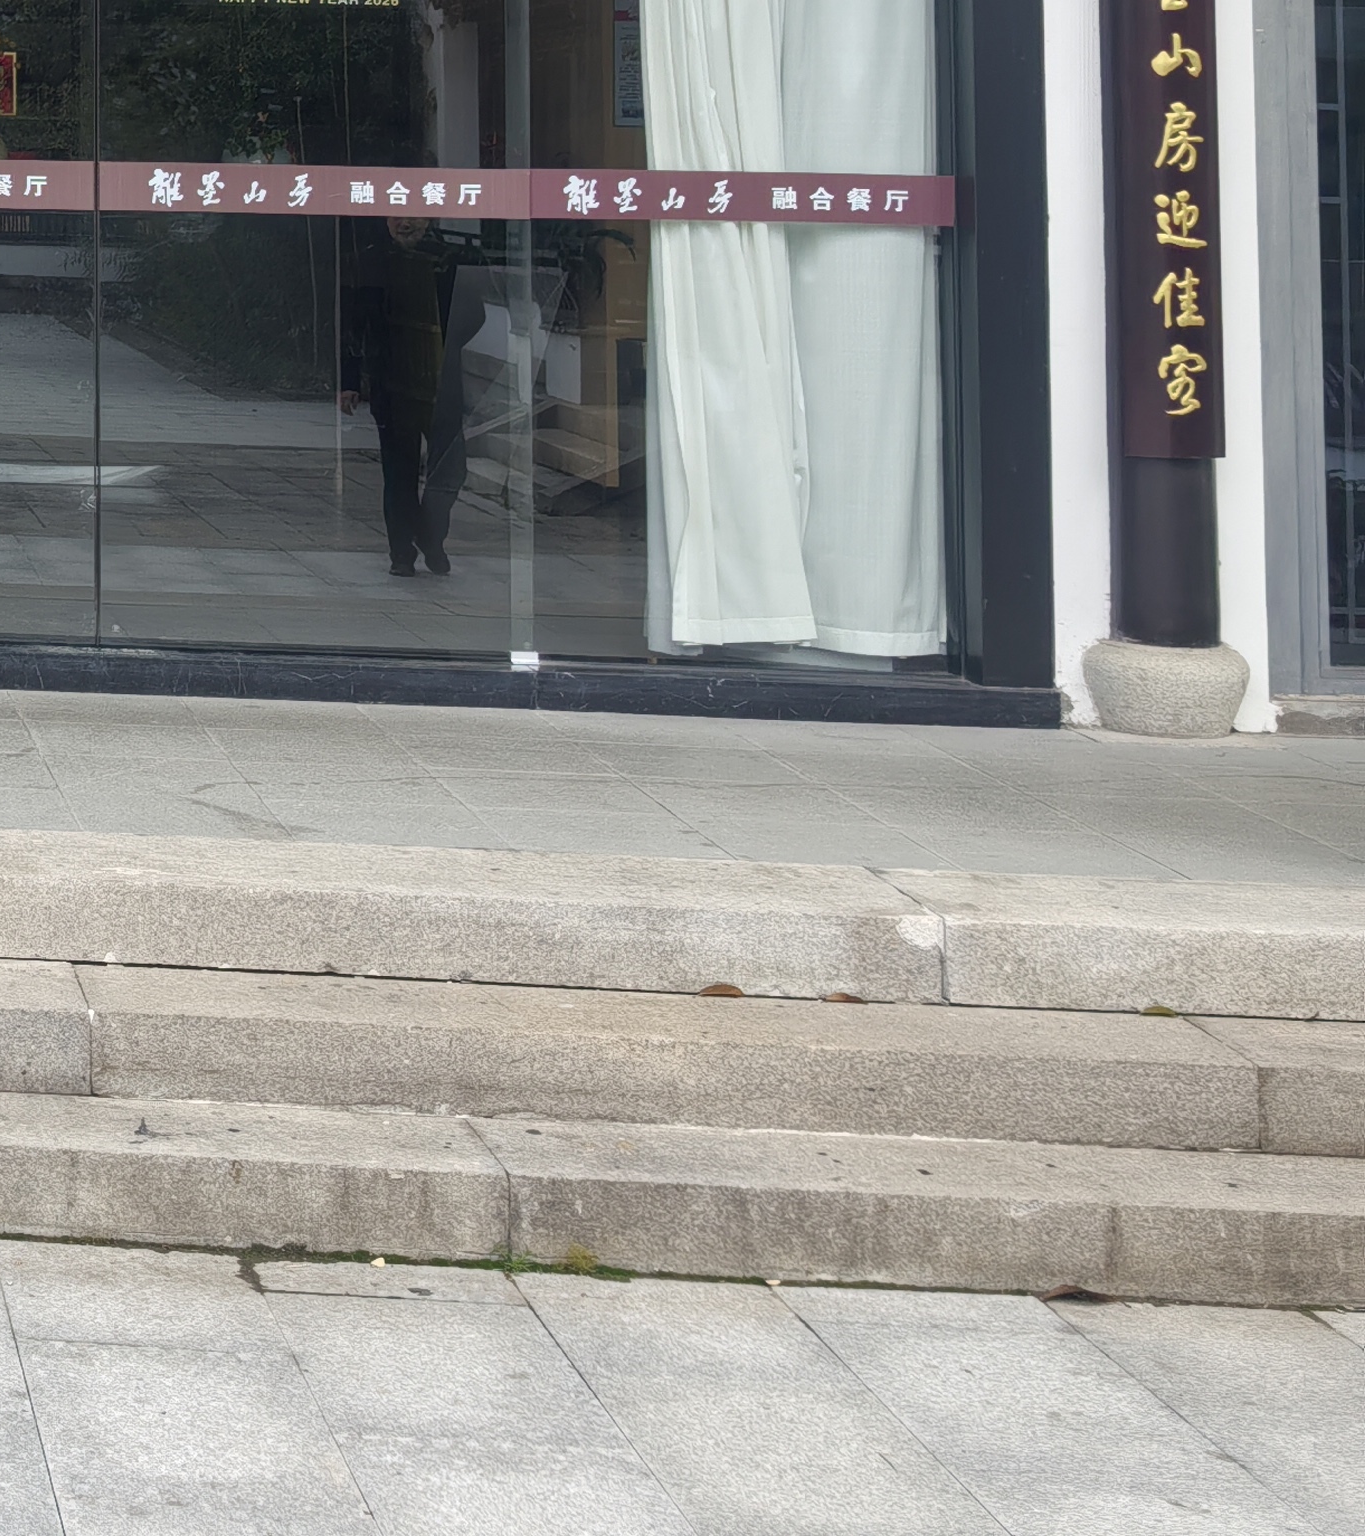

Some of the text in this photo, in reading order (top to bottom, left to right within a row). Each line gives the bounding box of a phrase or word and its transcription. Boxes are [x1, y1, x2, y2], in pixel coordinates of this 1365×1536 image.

[349, 180, 482, 206] 融合餐厅
[771, 186, 909, 212] 融合餐厅
